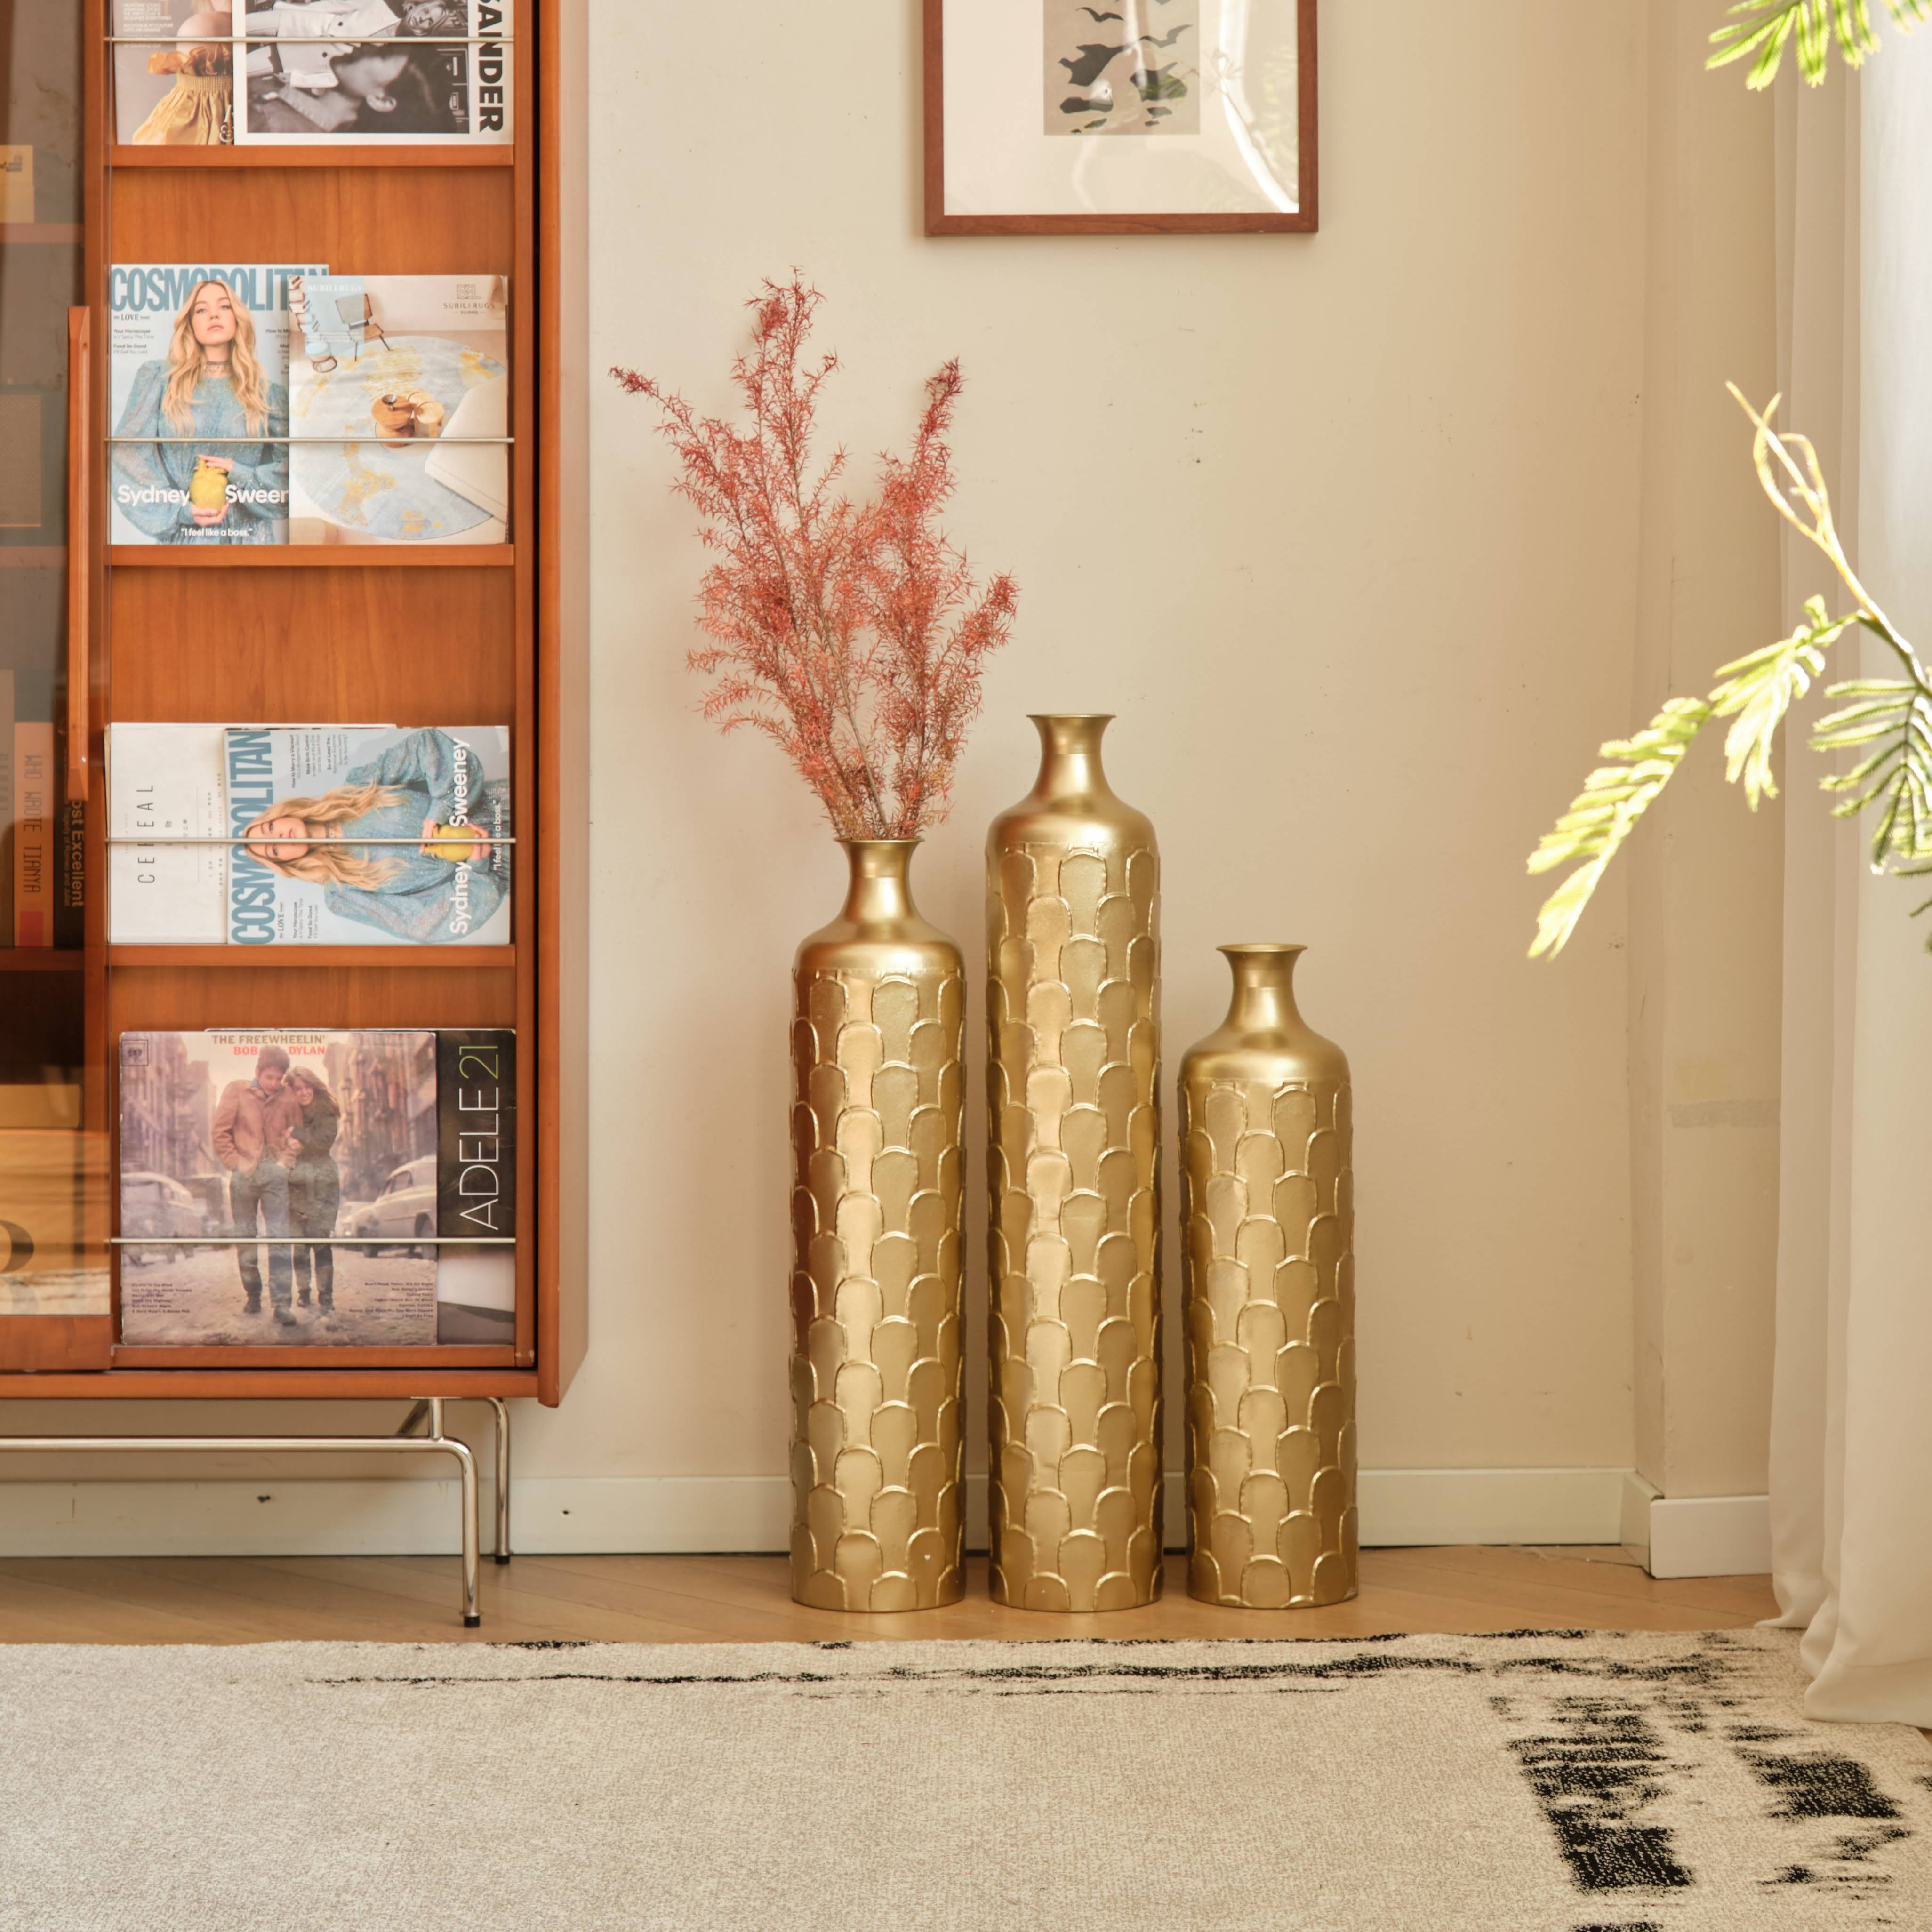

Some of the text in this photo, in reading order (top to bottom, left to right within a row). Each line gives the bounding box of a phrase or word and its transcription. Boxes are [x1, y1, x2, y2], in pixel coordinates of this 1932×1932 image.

[111, 268, 327, 312] COSMOLIT
[118, 484, 190, 507] Sydney
[189, 527, 204, 537] feel
[205, 527, 219, 537] like
[449, 738, 470, 827] Sweeney
[23, 754, 42, 893] WHO WROTE TIANYA
[227, 731, 275, 944] COSMOLITAN
[493, 832, 501, 846] le
[72, 801, 84, 907] ost Excellent
[493, 847, 501, 863] feel
[449, 862, 472, 934] Sydney
[212, 1035, 325, 1044] THE FREEWHEELIN'
[233, 1046, 325, 1055] BOB DYLAN
[459, 1046, 498, 1230] ADELE 21
